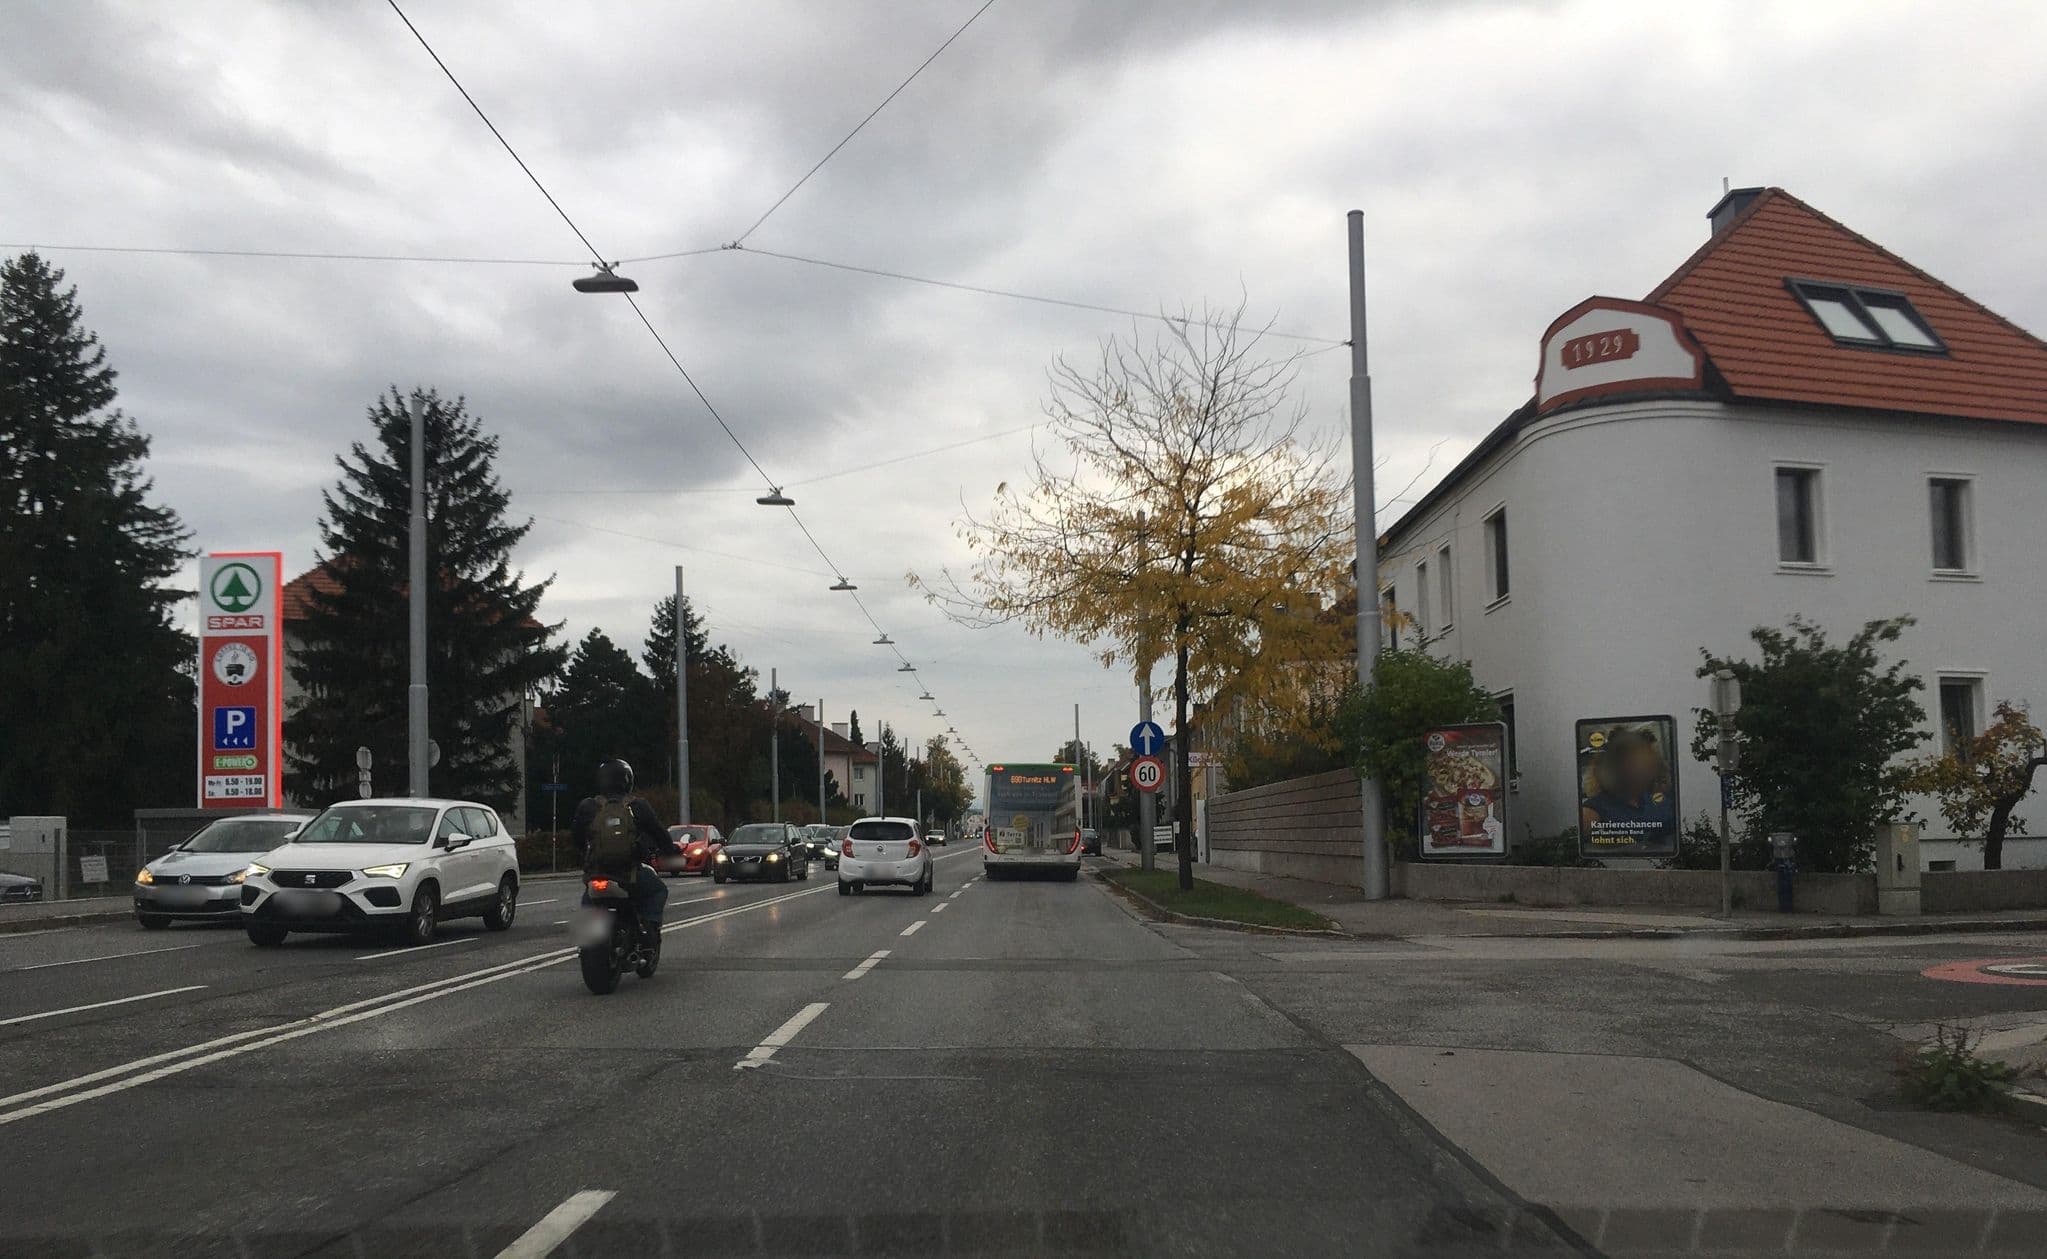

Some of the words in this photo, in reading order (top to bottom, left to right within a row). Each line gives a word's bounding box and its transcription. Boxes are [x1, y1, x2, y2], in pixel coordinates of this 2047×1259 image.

[1572, 335, 1623, 362] 1929
[208, 616, 262, 628] SPAR
[227, 710, 246, 735] P
[1139, 766, 1156, 782] 60
[1591, 820, 1663, 829] Karrierechancen
[1591, 836, 1615, 844] lohnt
